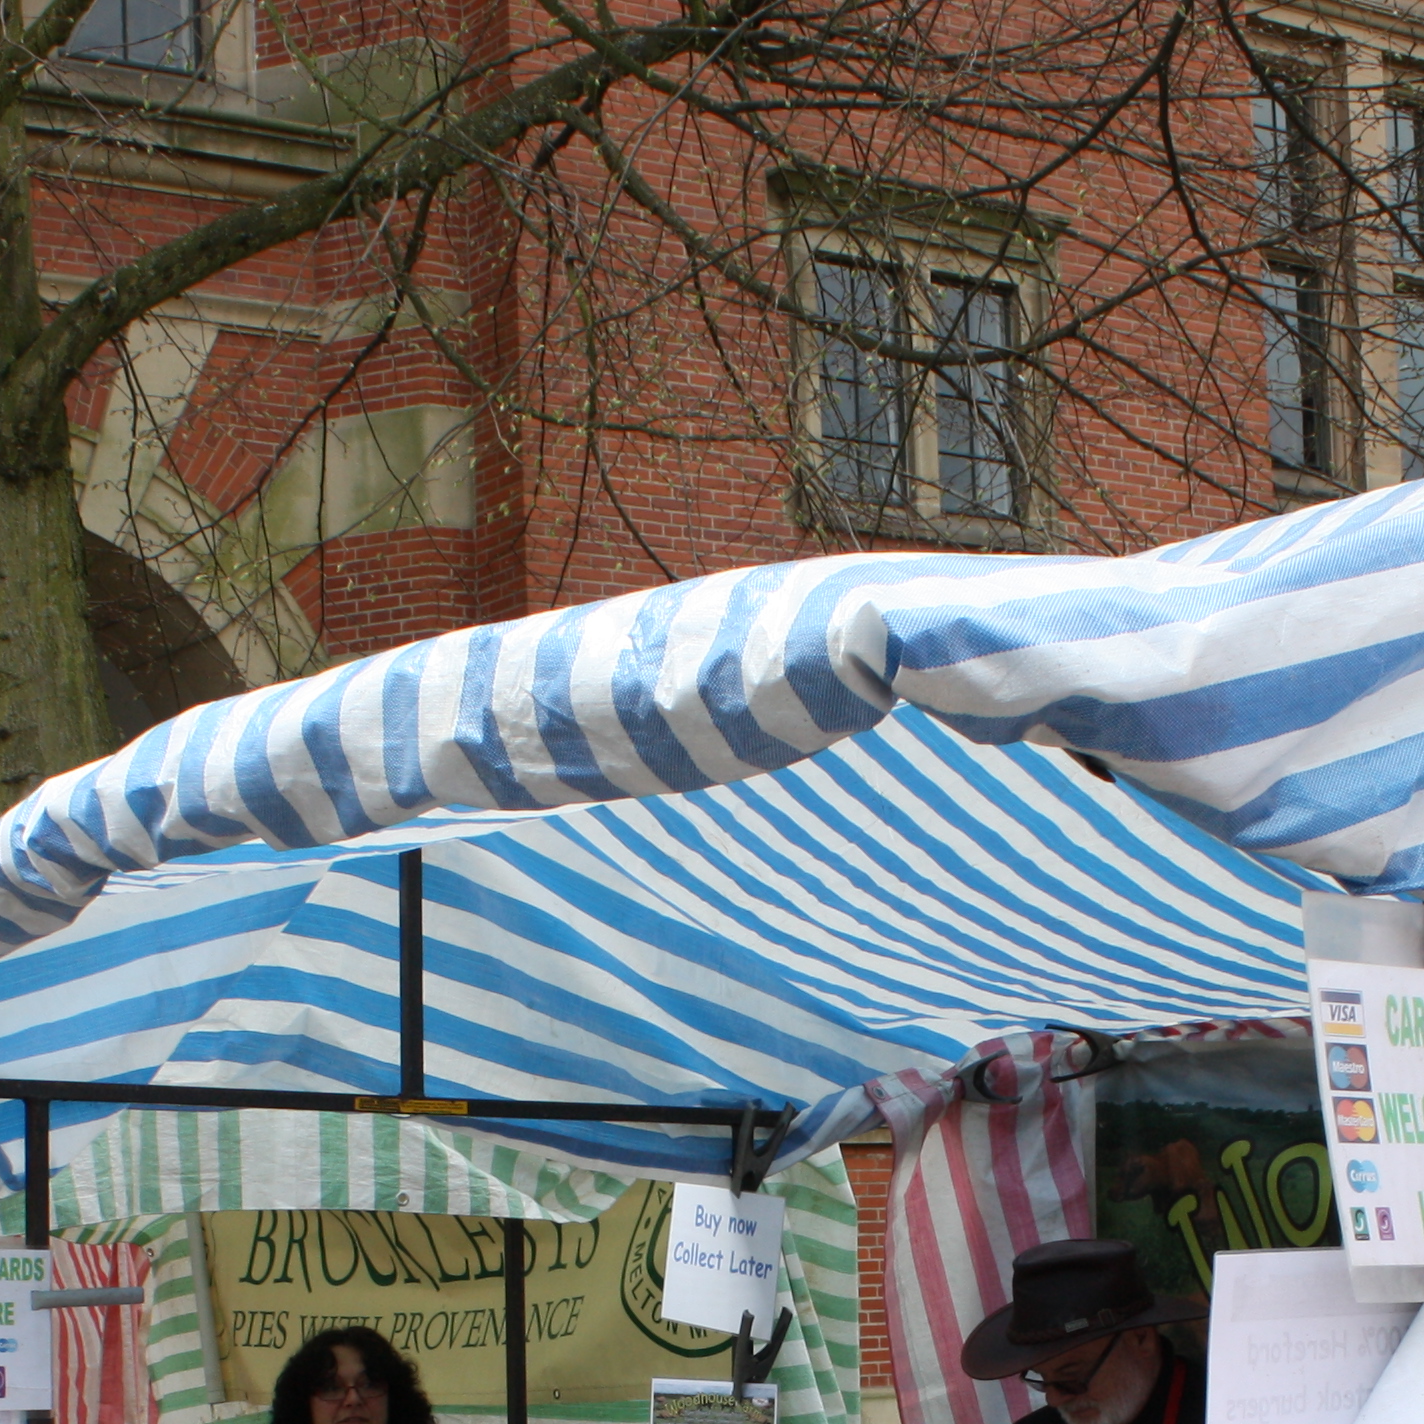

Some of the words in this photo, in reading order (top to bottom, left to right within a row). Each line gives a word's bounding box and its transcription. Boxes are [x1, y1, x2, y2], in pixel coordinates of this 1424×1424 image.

[1328, 1004, 1357, 1024] VISA
[1332, 1060, 1365, 1076] Maestro
[1337, 1112, 1375, 1129] MasterCard
[1350, 1168, 1376, 1182] Cirrus
[695, 1205, 722, 1237] Buy
[728, 1216, 757, 1236] now
[673, 1241, 723, 1271] Collect
[729, 1251, 773, 1279] Later
[232, 1310, 289, 1350] PIES
[389, 1295, 586, 1353] PROVENNCE
